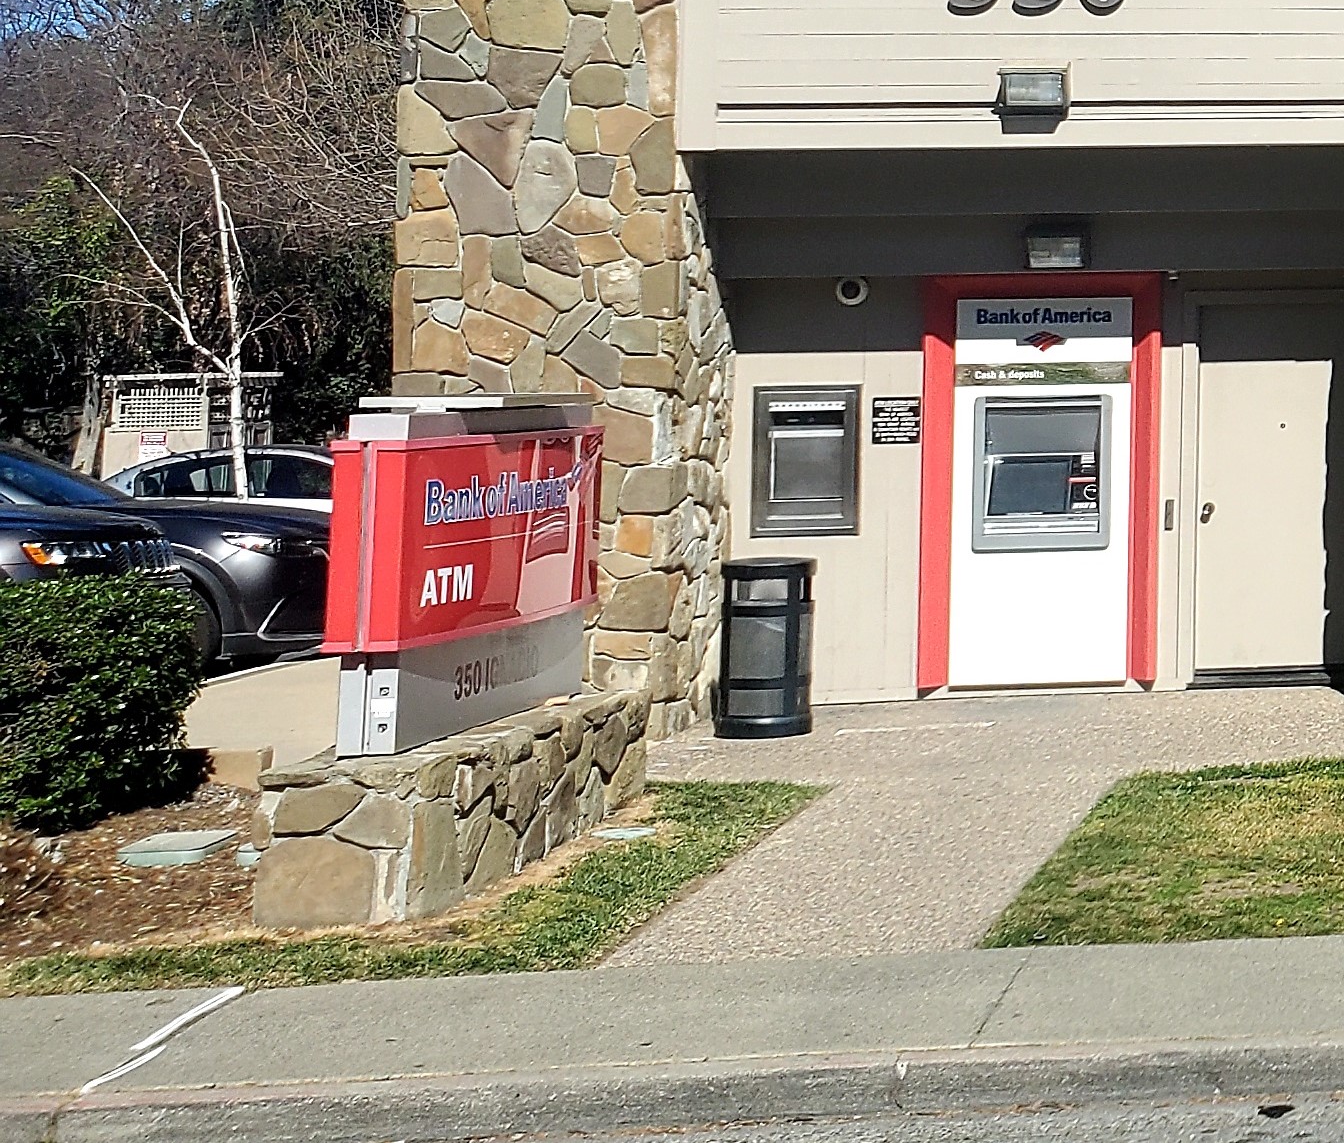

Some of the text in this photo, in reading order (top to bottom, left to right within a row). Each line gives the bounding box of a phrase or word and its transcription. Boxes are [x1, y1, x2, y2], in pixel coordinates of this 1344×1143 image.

[976, 307, 1112, 325] Bank of America
[974, 369, 1045, 381] Cash & deposits
[424, 467, 570, 526] Bank of America
[420, 563, 474, 608] ATM
[454, 660, 482, 700] 350
